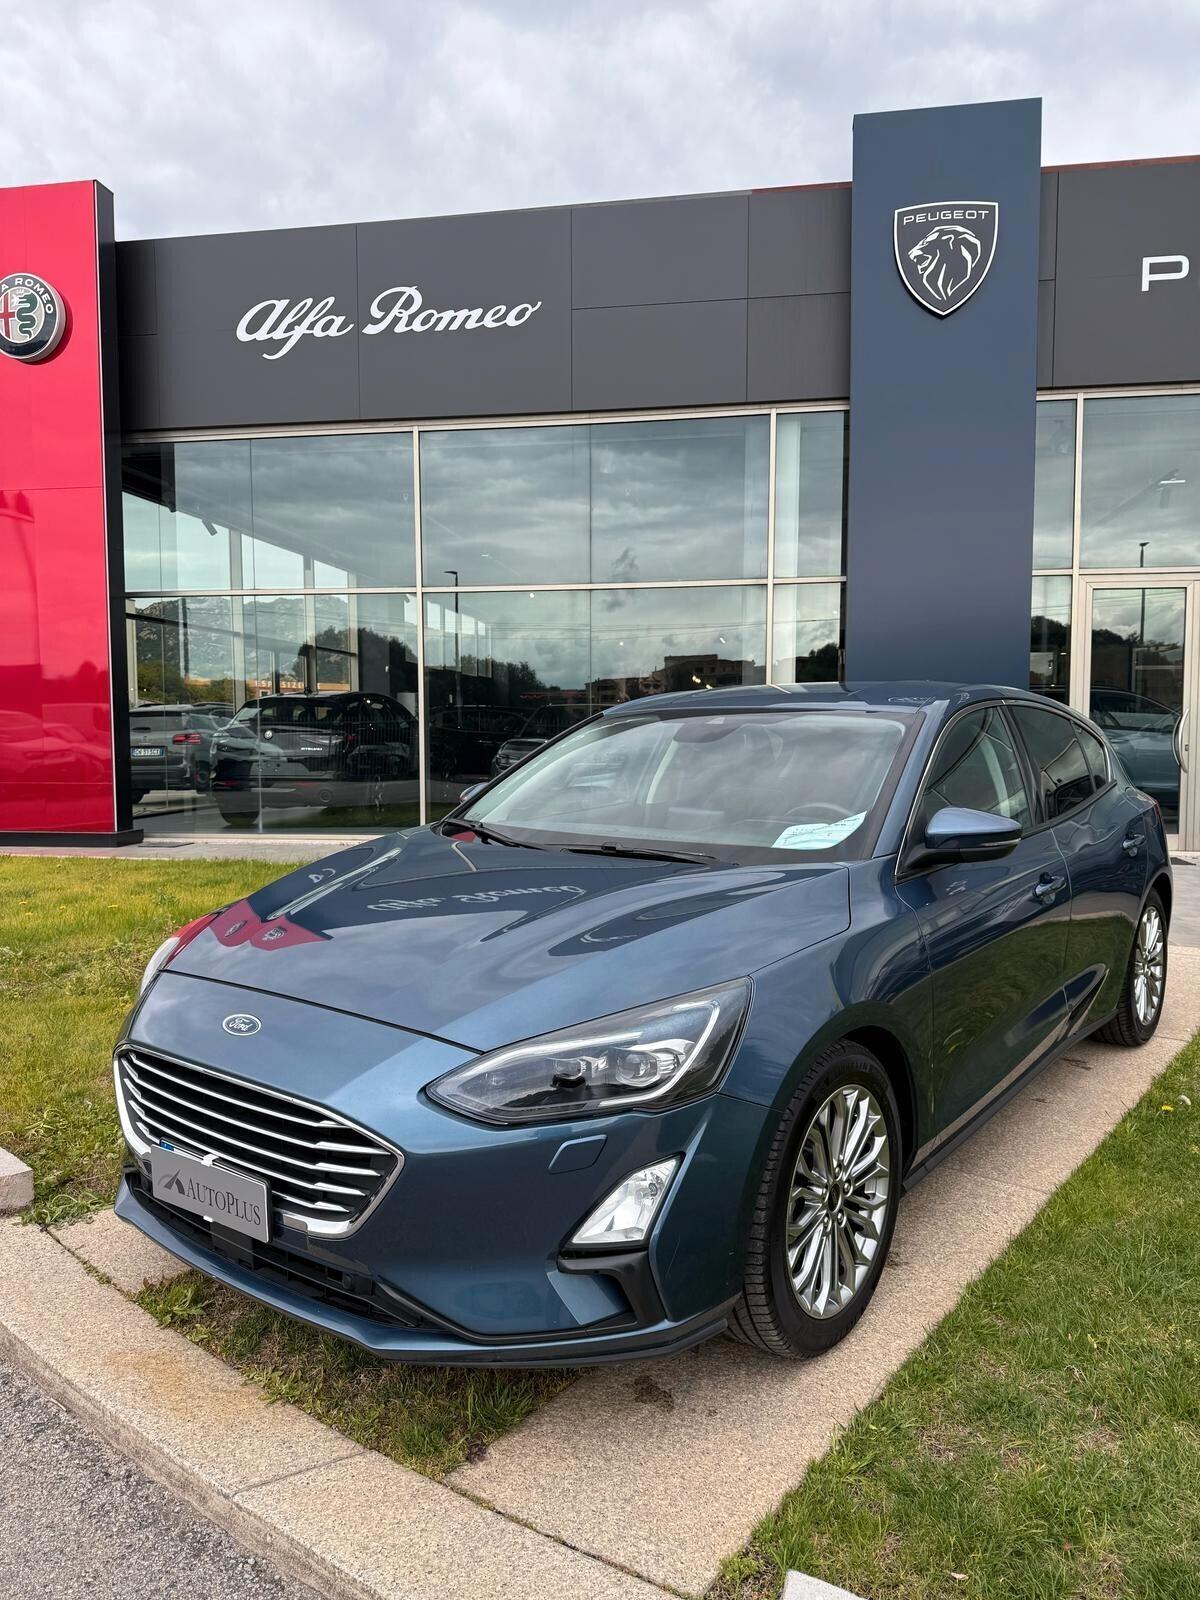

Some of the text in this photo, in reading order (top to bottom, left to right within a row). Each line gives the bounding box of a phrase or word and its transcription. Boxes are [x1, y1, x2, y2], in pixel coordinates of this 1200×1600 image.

[903, 210, 989, 225] PEUGEOT
[15, 278, 54, 314] ROMEO
[235, 285, 542, 360] Alfa Romeo
[229, 1017, 253, 1031] Ford
